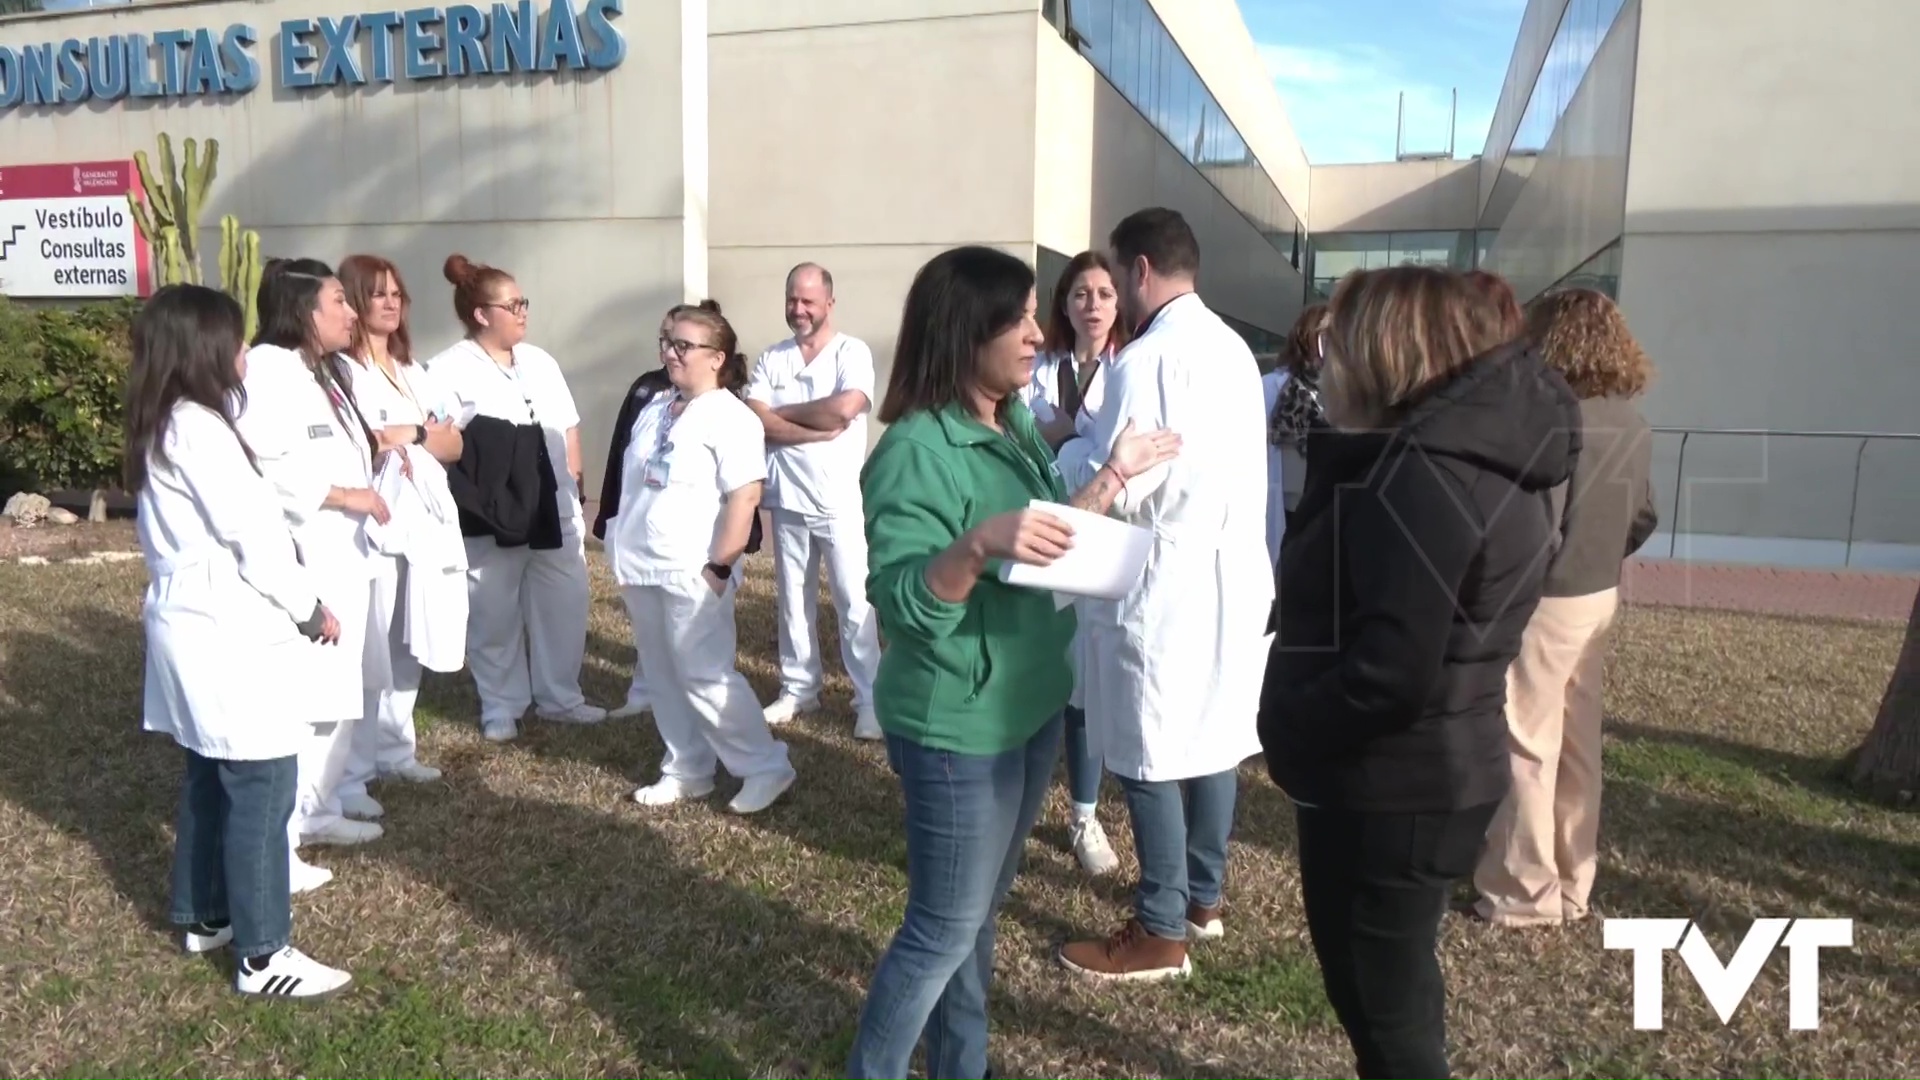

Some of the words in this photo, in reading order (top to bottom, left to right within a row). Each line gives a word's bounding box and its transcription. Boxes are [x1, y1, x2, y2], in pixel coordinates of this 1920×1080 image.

[279, 0, 627, 87] EXTERNAS
[35, 205, 123, 229] Vestíbulo
[40, 237, 126, 259] Consultas
[54, 265, 127, 285] externas
